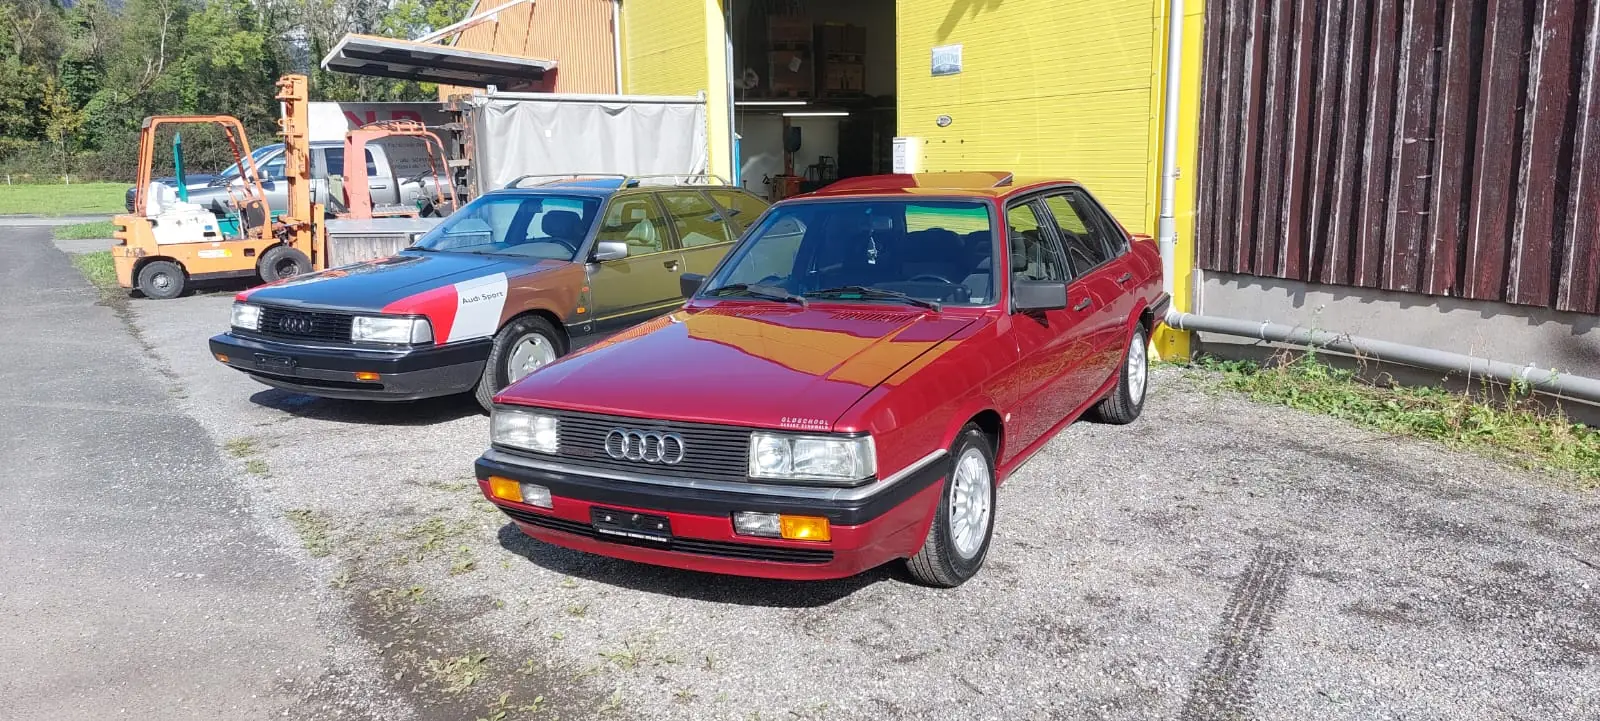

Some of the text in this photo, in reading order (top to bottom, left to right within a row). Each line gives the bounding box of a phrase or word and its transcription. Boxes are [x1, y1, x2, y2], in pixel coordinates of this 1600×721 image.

[462, 292, 503, 304] Audi Sport
[781, 416, 829, 425] OLDSCHOOL
